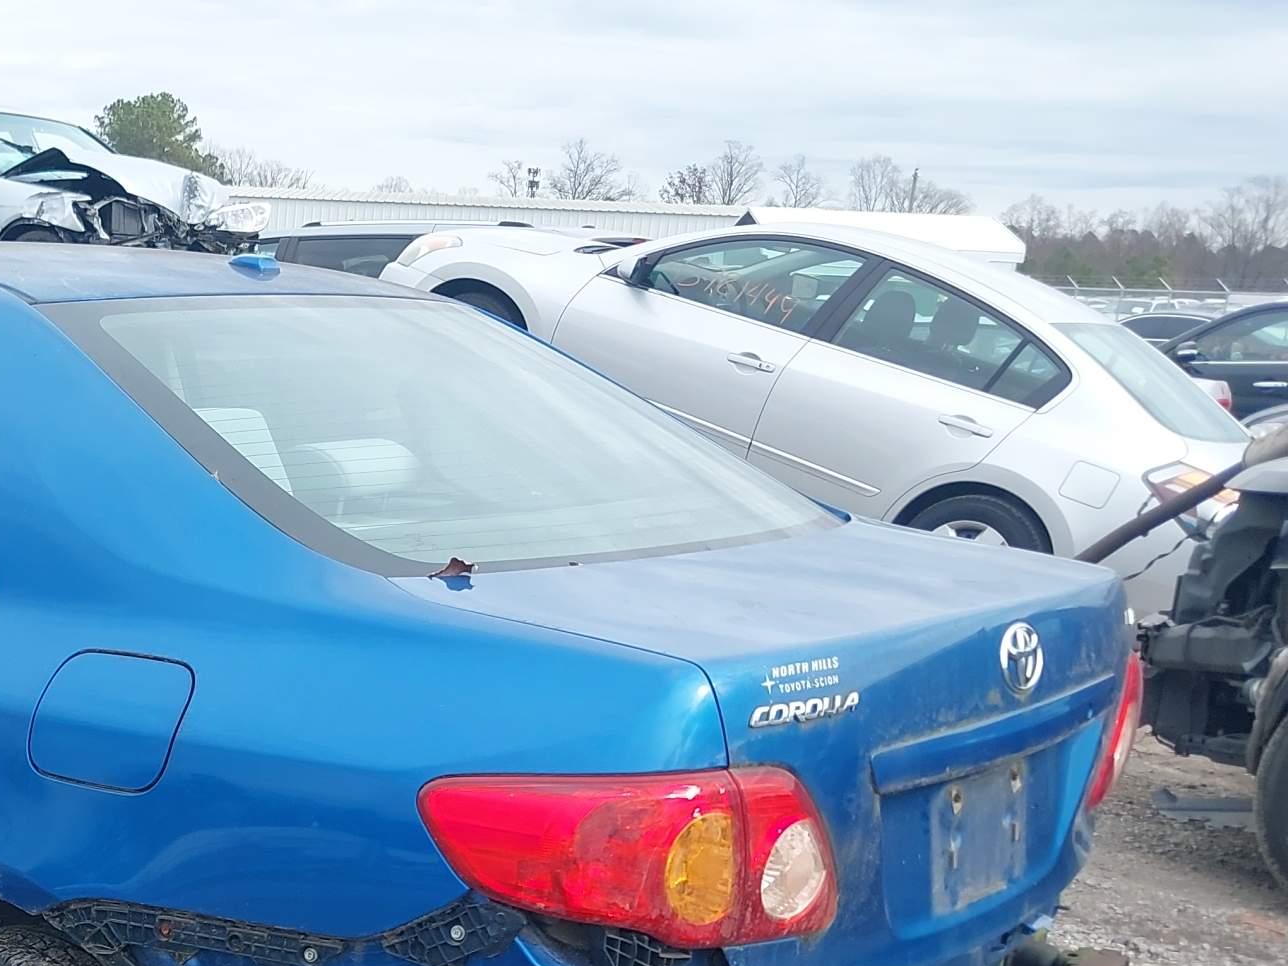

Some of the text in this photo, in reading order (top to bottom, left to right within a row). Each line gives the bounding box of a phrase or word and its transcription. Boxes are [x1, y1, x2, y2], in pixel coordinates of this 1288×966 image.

[773, 657, 839, 678] NORTH HILLS
[750, 691, 860, 727] COROLLA
